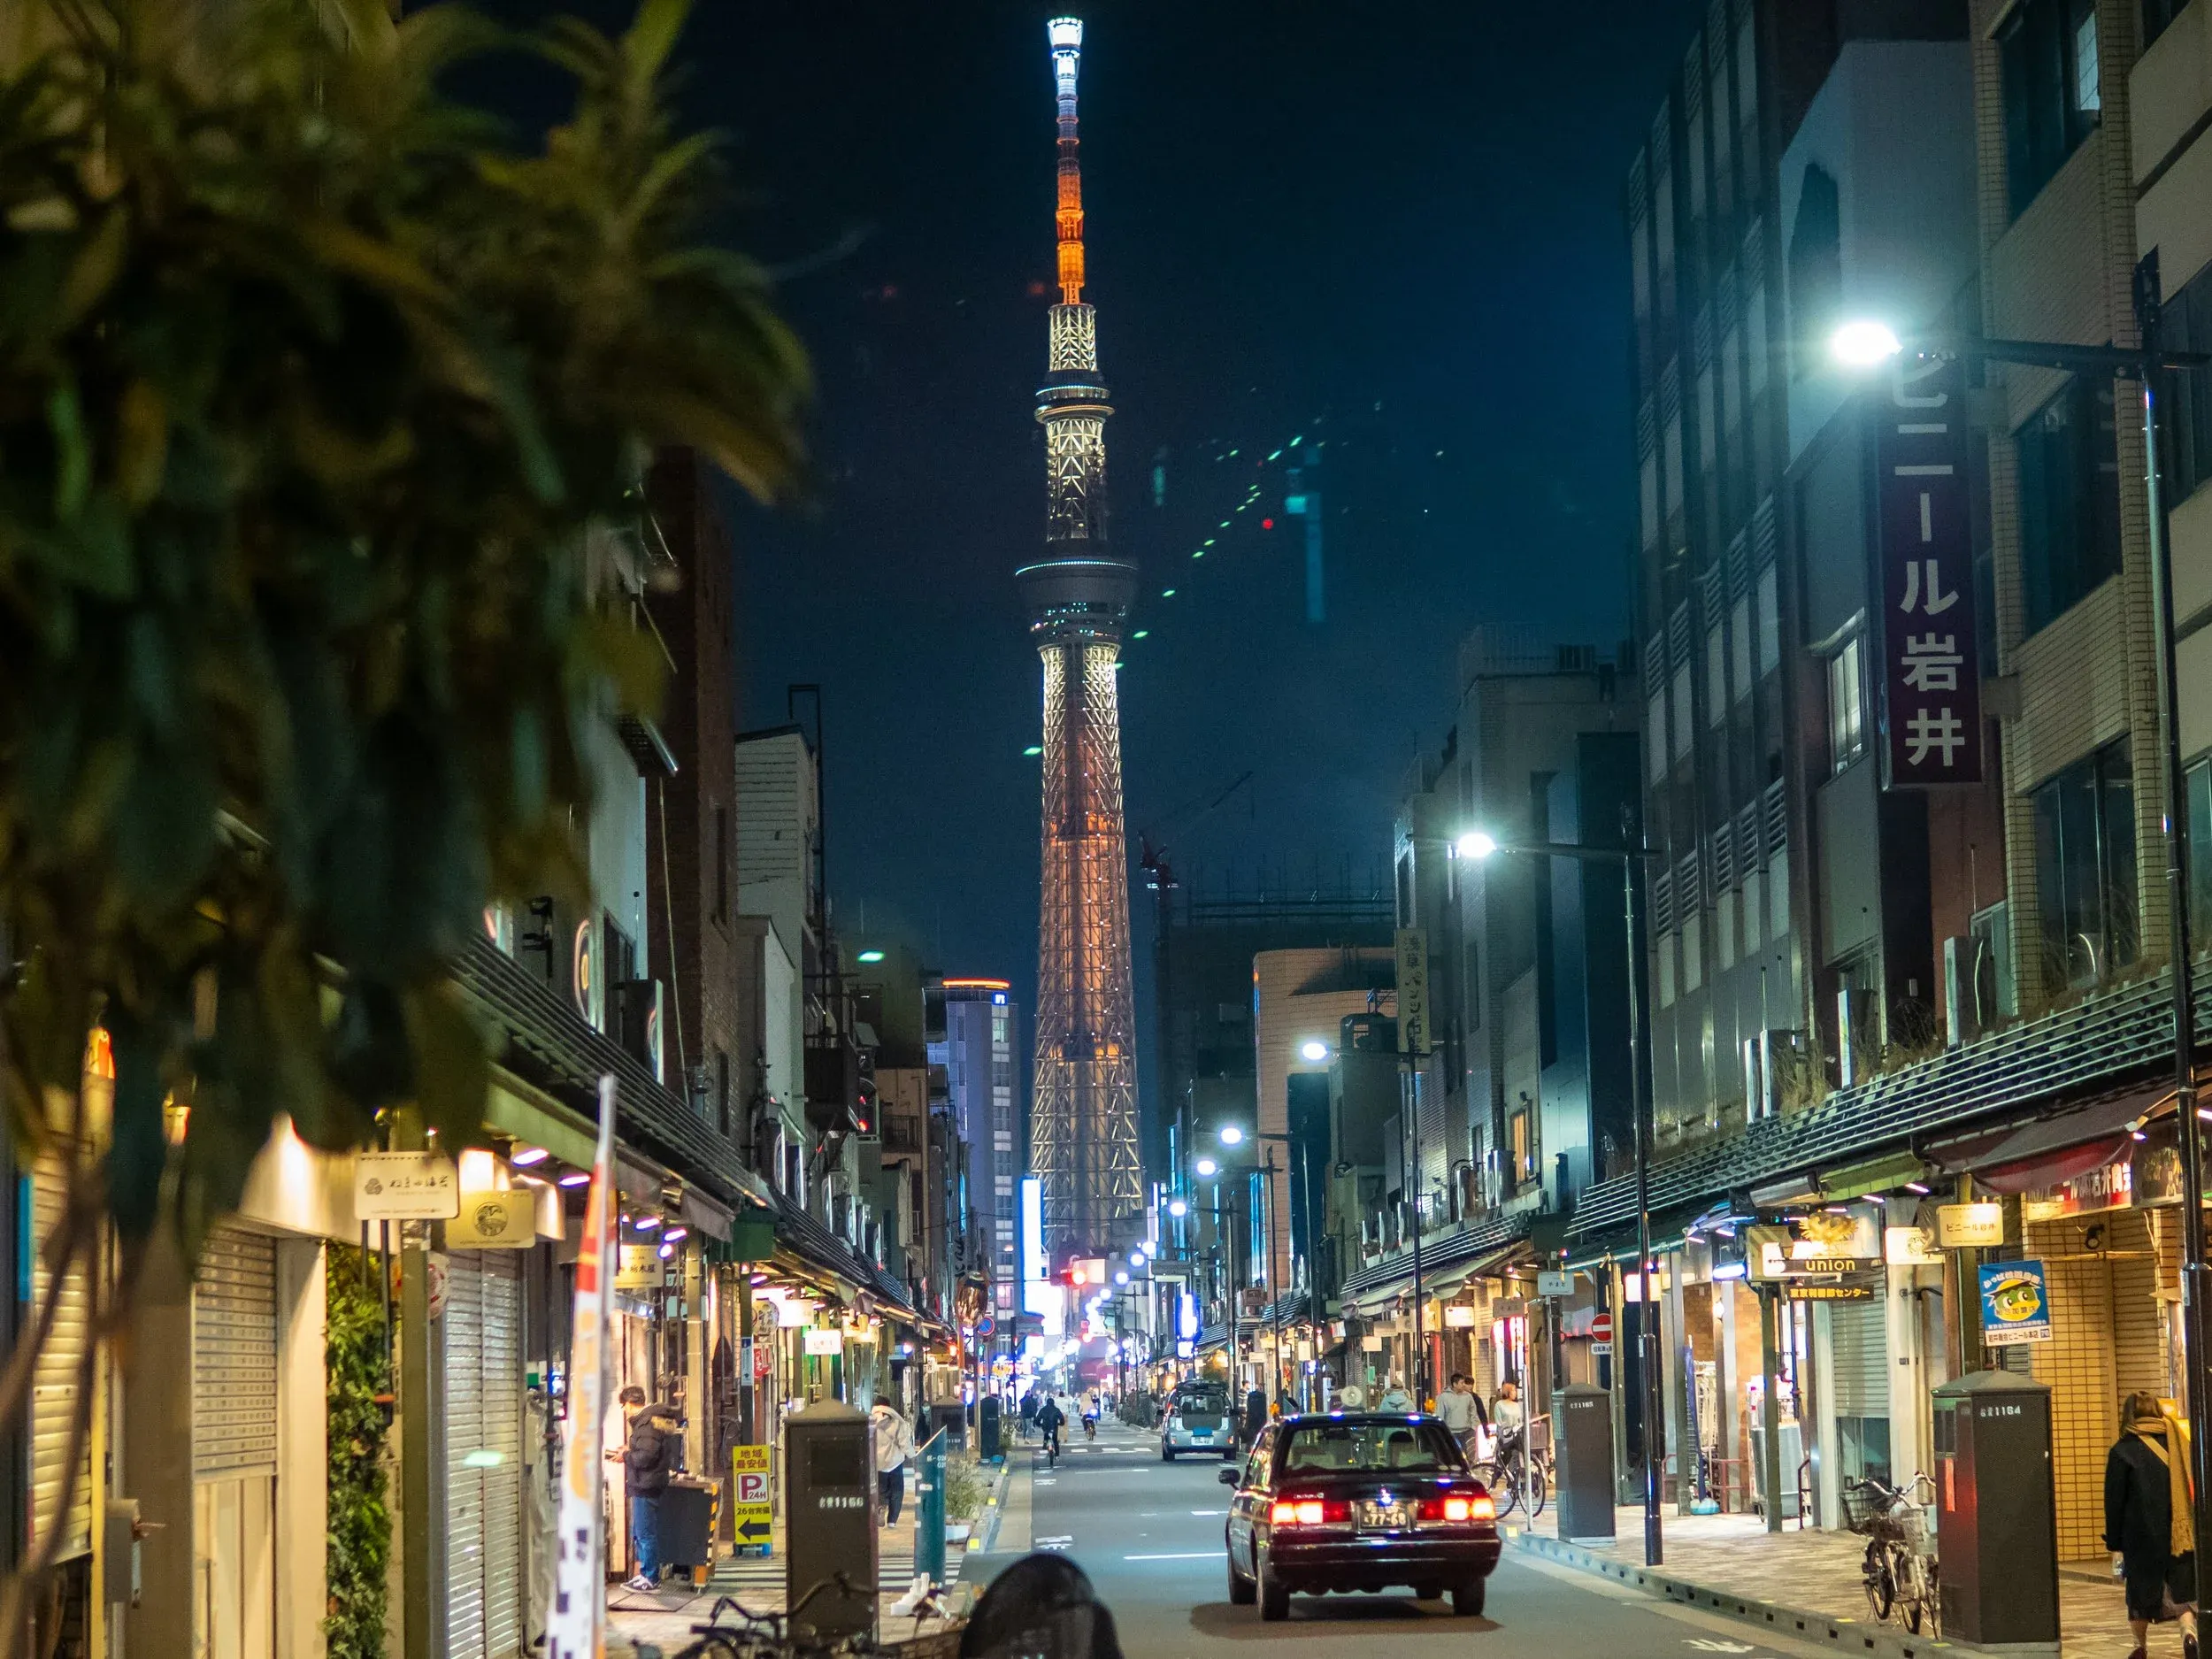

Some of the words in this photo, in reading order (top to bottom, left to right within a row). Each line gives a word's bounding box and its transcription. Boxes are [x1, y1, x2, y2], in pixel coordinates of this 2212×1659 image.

[1893, 349, 1966, 768] ビニール岩井
[1805, 1259, 1855, 1271] union
[741, 1448, 763, 1458] 地域
[736, 1459, 767, 1469] 最安値
[741, 1475, 763, 1501] P
[749, 1491, 766, 1500] 24H
